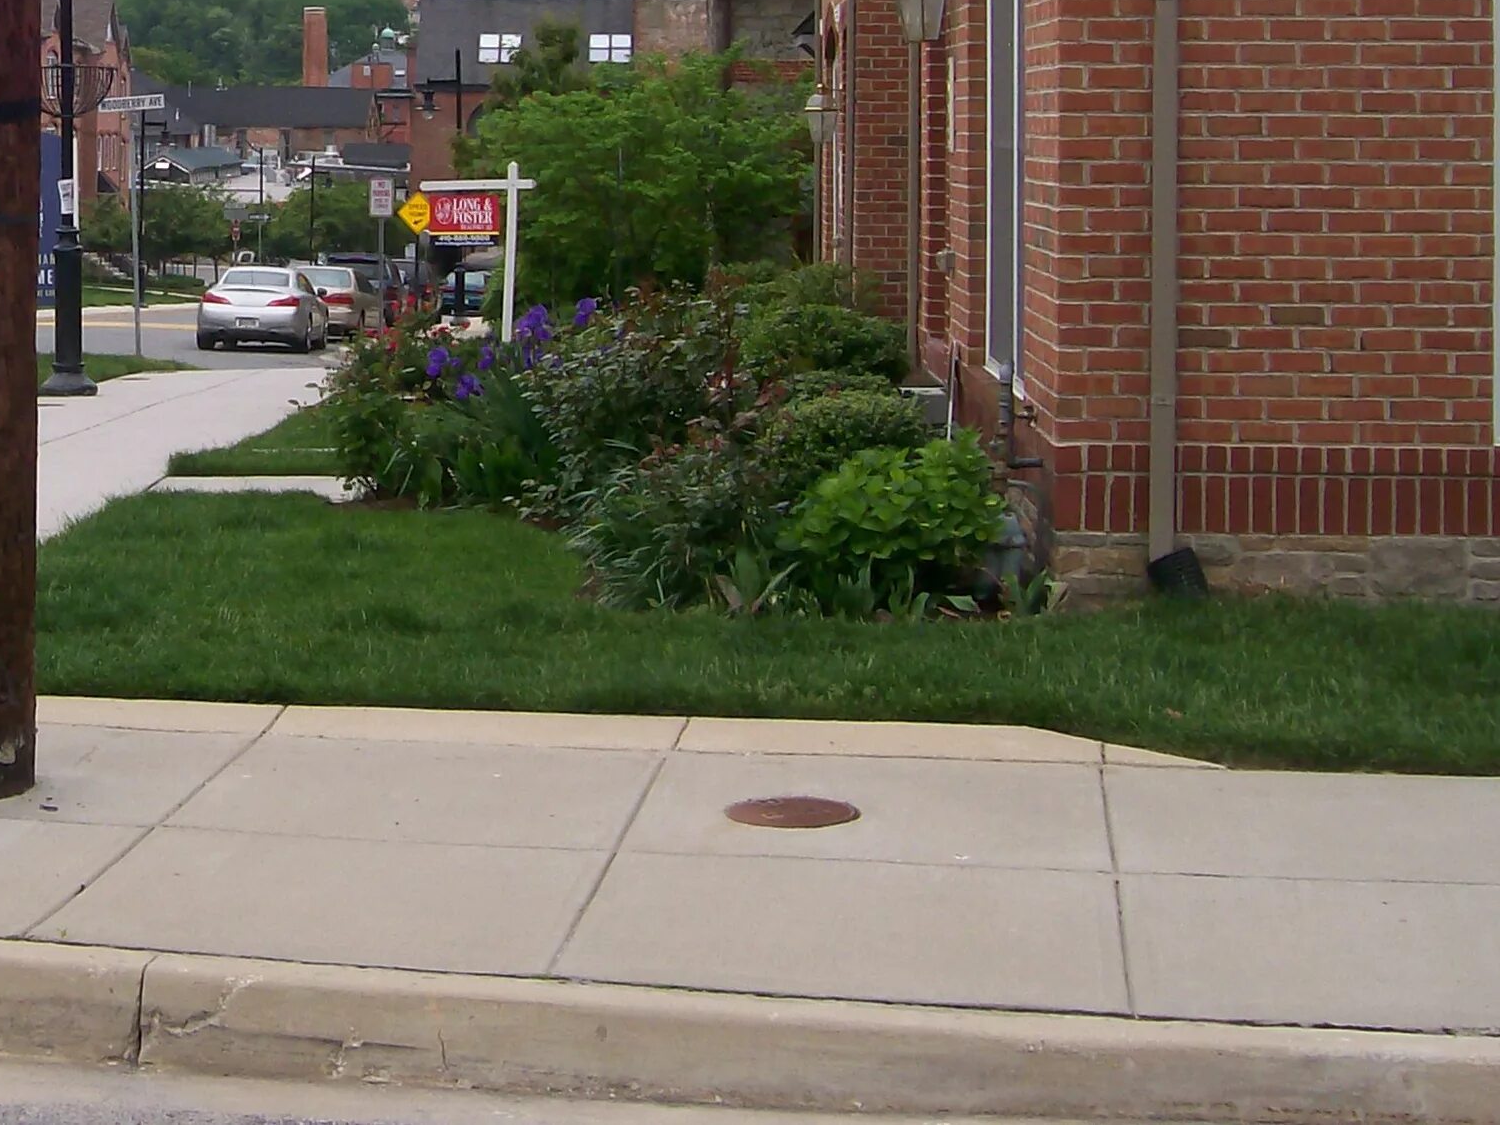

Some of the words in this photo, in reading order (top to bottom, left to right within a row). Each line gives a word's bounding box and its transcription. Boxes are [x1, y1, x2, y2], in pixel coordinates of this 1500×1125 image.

[149, 96, 163, 107] AVE
[453, 197, 481, 211] LONG
[484, 197, 492, 211] &
[453, 211, 493, 224] FOSTER
